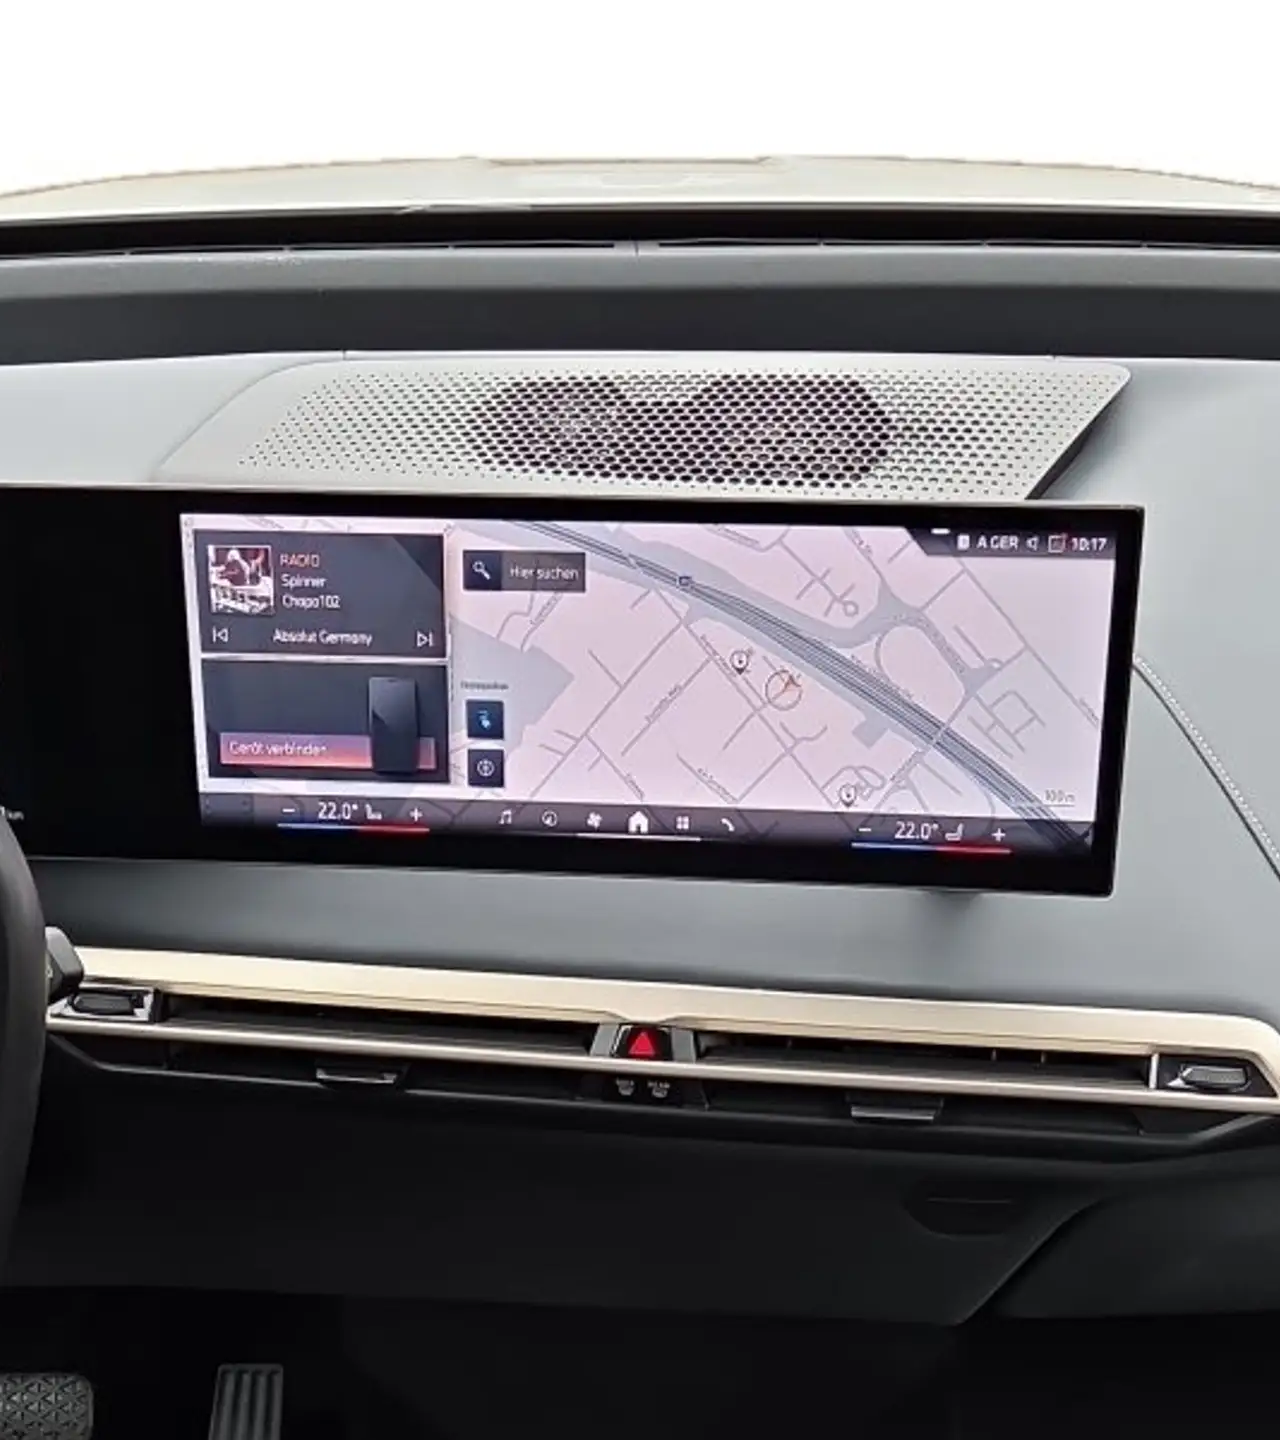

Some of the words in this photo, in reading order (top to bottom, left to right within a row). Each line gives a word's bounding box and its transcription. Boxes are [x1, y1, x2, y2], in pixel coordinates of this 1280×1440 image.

[976, 535, 988, 549] A
[990, 534, 1019, 549] GER
[1071, 537, 1108, 551] 10:17
[280, 553, 321, 569] RADIO
[509, 563, 534, 580] Hier
[536, 565, 580, 581] suchen
[280, 573, 327, 590] Spinner
[273, 628, 318, 644] Absolut
[318, 628, 374, 648] Germany
[266, 740, 328, 757] verbinden
[317, 800, 359, 821] 22.0°
[893, 820, 940, 840] 22.0°
